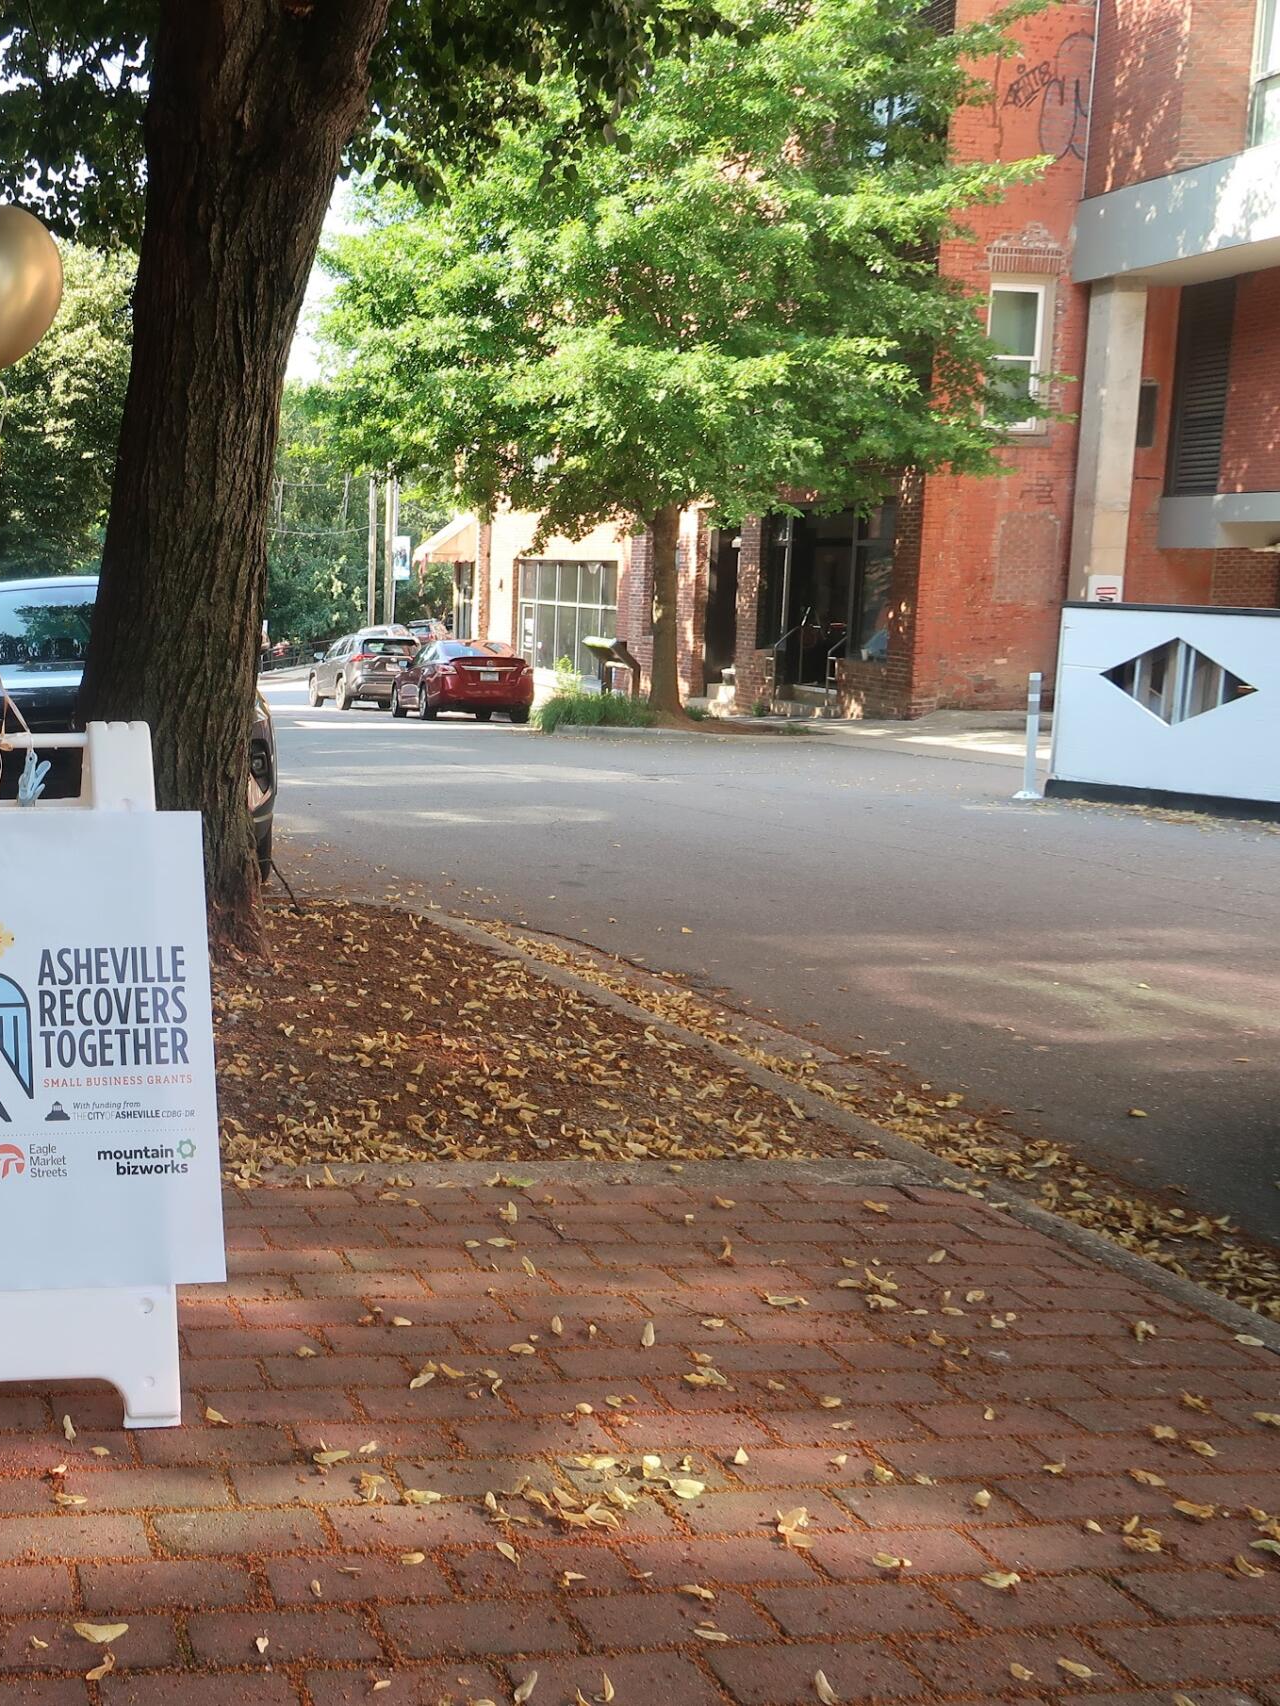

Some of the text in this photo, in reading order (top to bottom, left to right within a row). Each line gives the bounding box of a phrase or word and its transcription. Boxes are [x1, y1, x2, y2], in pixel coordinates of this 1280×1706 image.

[38, 946, 186, 986] ASHEVILLE
[39, 986, 188, 1026] RECOVERS
[40, 1027, 189, 1068] TOGETHER
[43, 1074, 193, 1088] SMALL BUSINESS GRANTS
[92, 1101, 122, 1110] funding
[122, 1100, 140, 1108] from
[30, 1144, 56, 1156] Eagle
[98, 1145, 174, 1160] mountain
[30, 1154, 66, 1166] Market
[30, 1166, 68, 1178] Streets
[116, 1160, 188, 1176] bizworks
